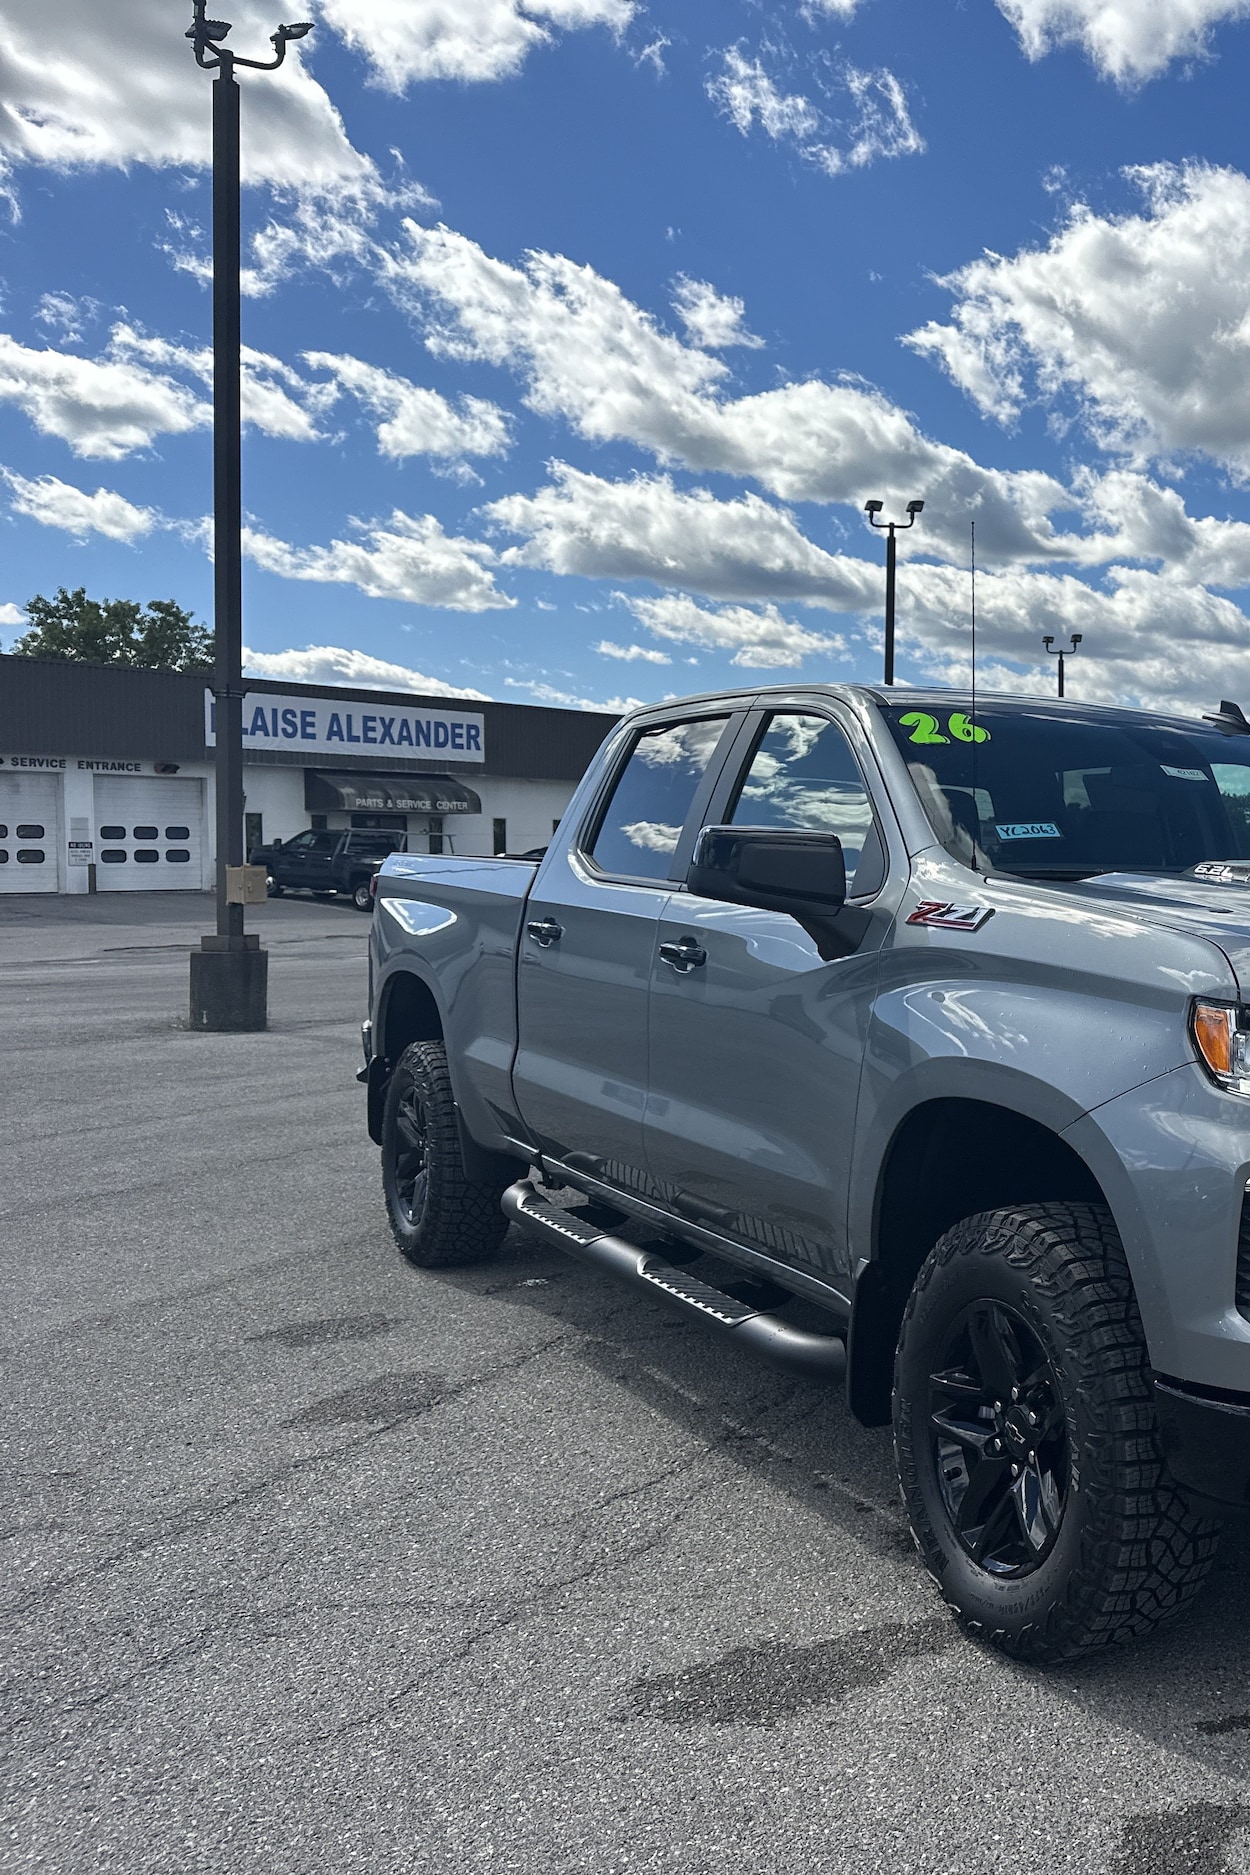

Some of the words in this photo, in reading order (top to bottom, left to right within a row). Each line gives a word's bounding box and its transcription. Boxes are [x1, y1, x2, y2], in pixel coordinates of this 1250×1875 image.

[211, 703, 316, 740] AISE
[325, 712, 481, 751] ALEXANDER
[899, 711, 992, 745] 26
[11, 757, 67, 769] SERVICE
[77, 760, 142, 772] ENTRANCE
[355, 798, 384, 808] PARTS
[386, 800, 393, 808] &
[396, 799, 431, 810] SERVICE
[436, 801, 468, 810] CENTER
[1193, 863, 1234, 879] 6.2L
[905, 900, 997, 932] Z71
